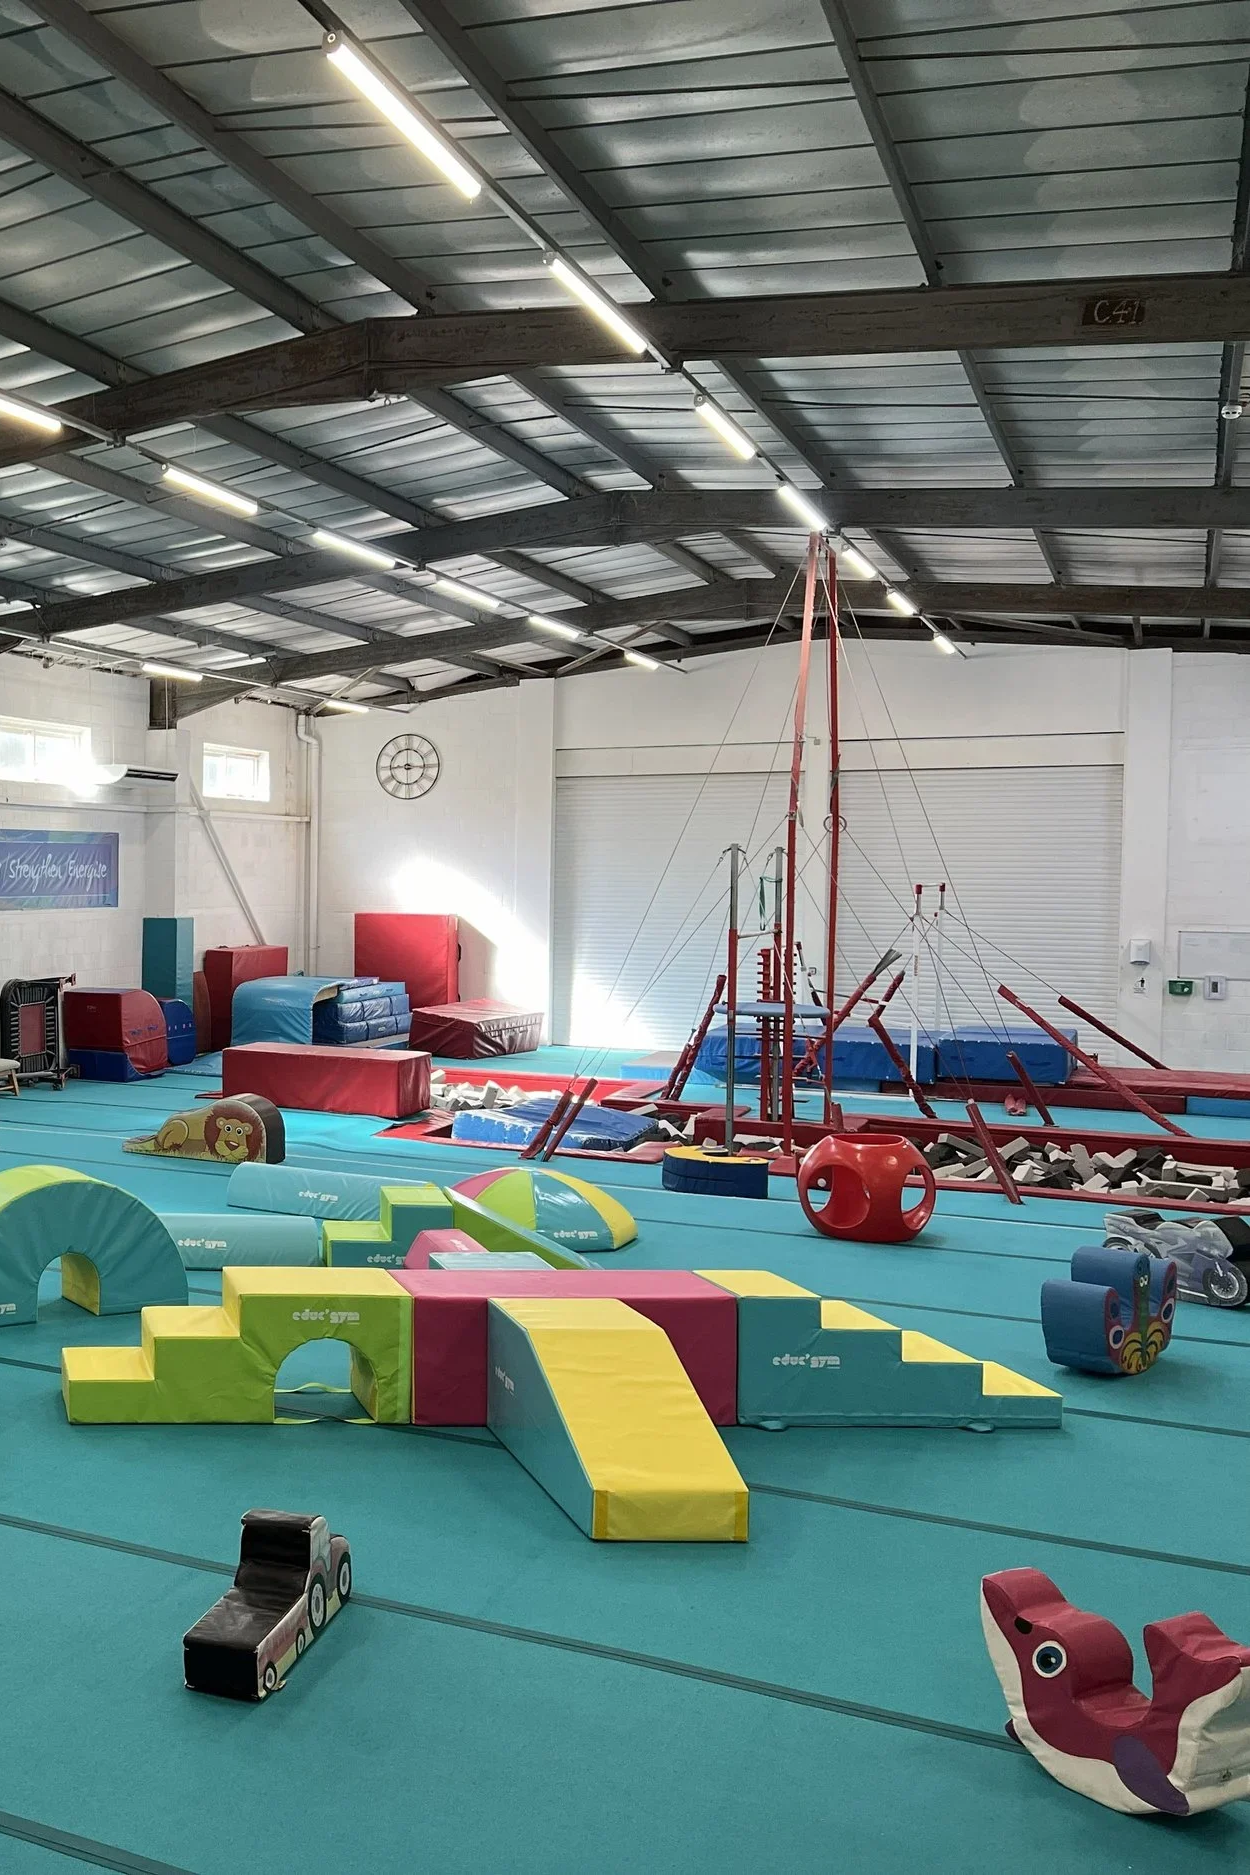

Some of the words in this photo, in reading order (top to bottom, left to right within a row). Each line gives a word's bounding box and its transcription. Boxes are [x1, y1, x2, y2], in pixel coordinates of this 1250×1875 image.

[9, 853, 62, 893] Strengthen
[68, 860, 107, 892] Energise
[292, 1309, 360, 1324] educ'gym
[772, 1353, 840, 1369] educ'gym
